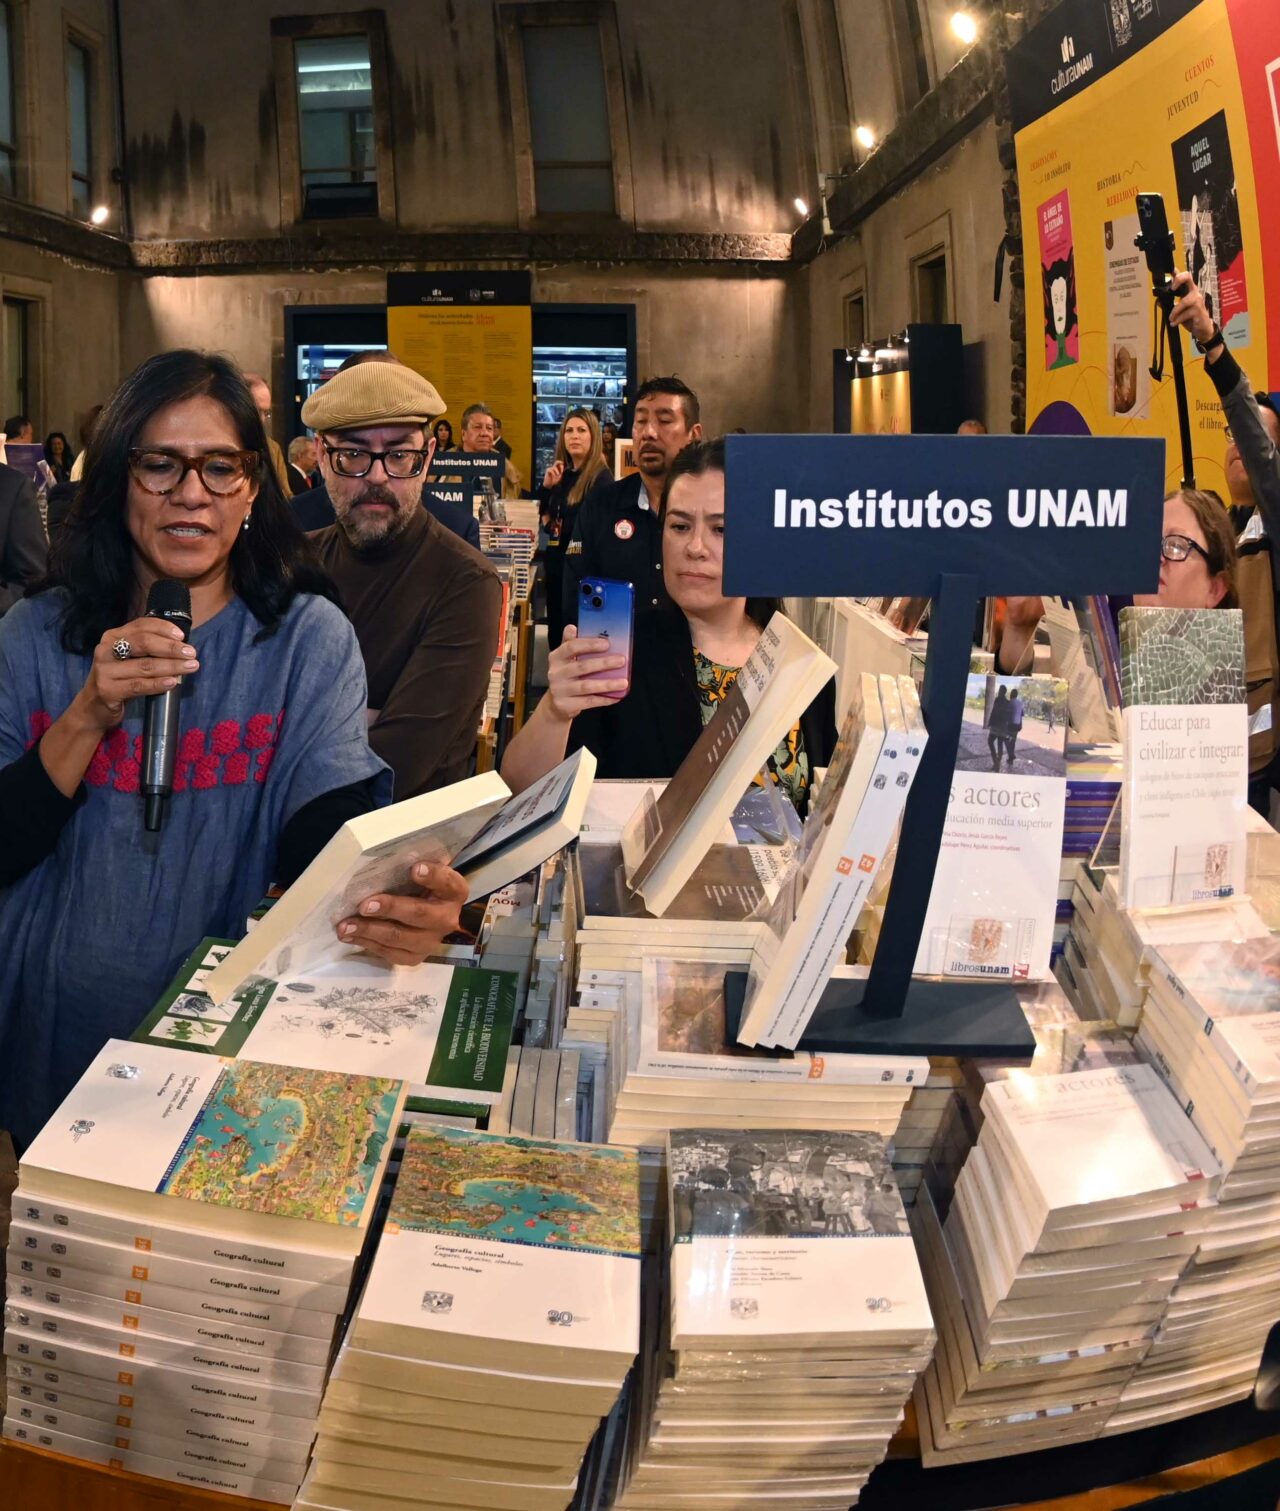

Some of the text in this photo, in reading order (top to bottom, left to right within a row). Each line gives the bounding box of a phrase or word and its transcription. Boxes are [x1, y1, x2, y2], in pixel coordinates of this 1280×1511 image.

[1051, 52, 1094, 95] culturaUNAM
[1185, 55, 1215, 82] CUENTOS
[1167, 90, 1199, 121] JUVENTUD
[1190, 137, 1210, 158] AQUEL
[1192, 152, 1212, 173] LUGAR
[1097, 173, 1122, 191] HISTORIA
[1199, 418, 1206, 429] el
[433, 458, 471, 466] Institutos
[431, 491, 464, 502] NAM
[774, 489, 1128, 528] Institutos UNAM
[1140, 711, 1210, 736] Educar para
[1139, 740, 1244, 764] civilizar e integrar:
[964, 785, 1041, 808] actores
[945, 812, 1053, 831] ducación media superior
[950, 961, 1010, 975] librosunam
[483, 1024, 493, 1032] LA
[473, 1032, 491, 1081] BIODIVERSIDAD
[1057, 1072, 1136, 1093] actores
[213, 1249, 285, 1267] Geografía cultural
[435, 1244, 504, 1258] Geografía cultural
[210, 1278, 280, 1295] Geografía cultural
[201, 1303, 270, 1320] Geografía cultural
[197, 1328, 265, 1346] Geografía cultural
[193, 1356, 260, 1373] Geografía cultural
[191, 1384, 257, 1402] Geografía cultural
